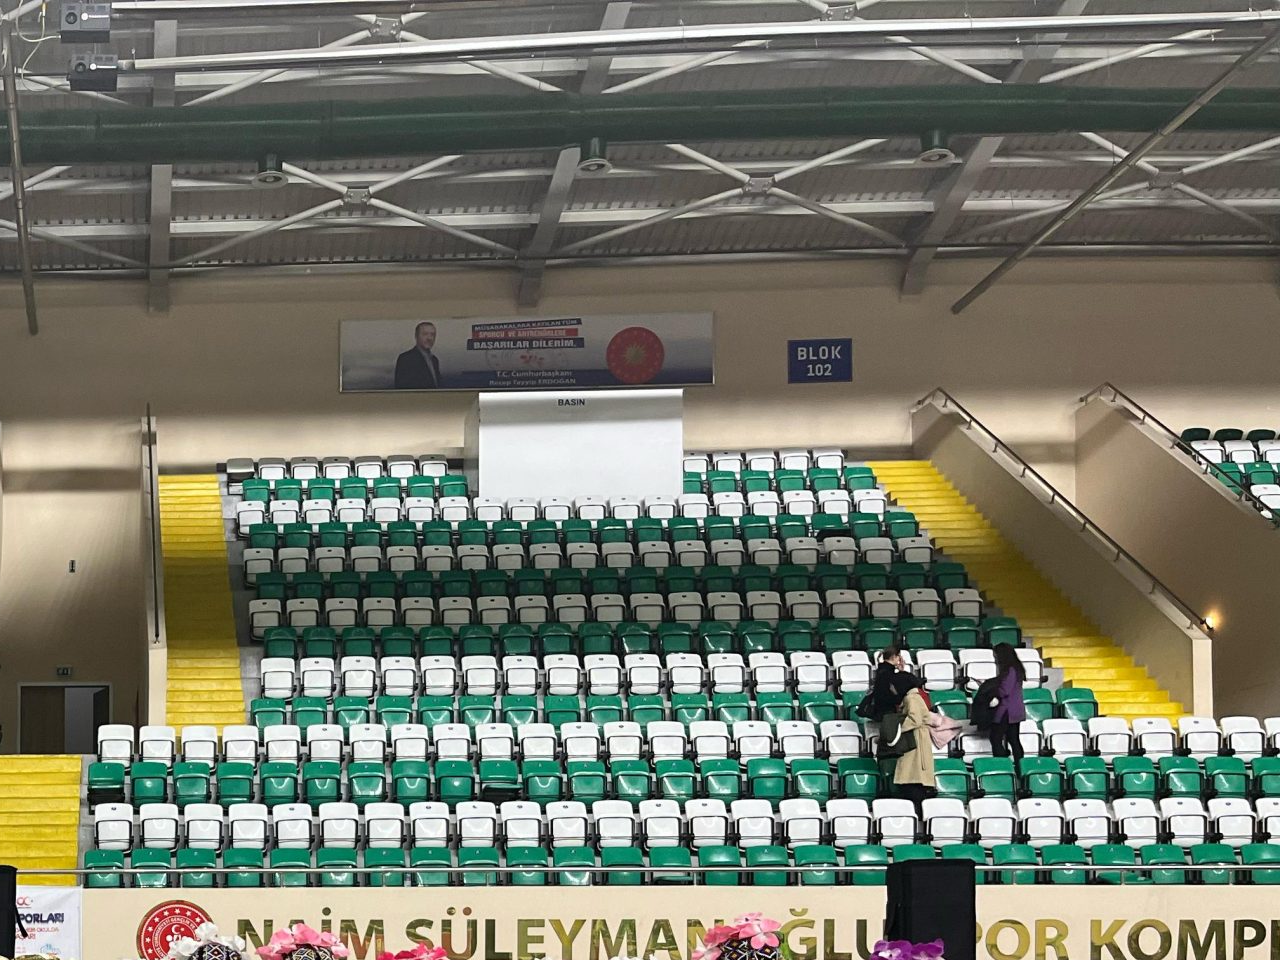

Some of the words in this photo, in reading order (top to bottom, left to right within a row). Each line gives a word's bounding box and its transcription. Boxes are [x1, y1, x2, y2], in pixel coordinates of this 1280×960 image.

[473, 340, 530, 350] BAŞARILAR
[797, 346, 842, 360] BLOK
[807, 363, 832, 377] 102
